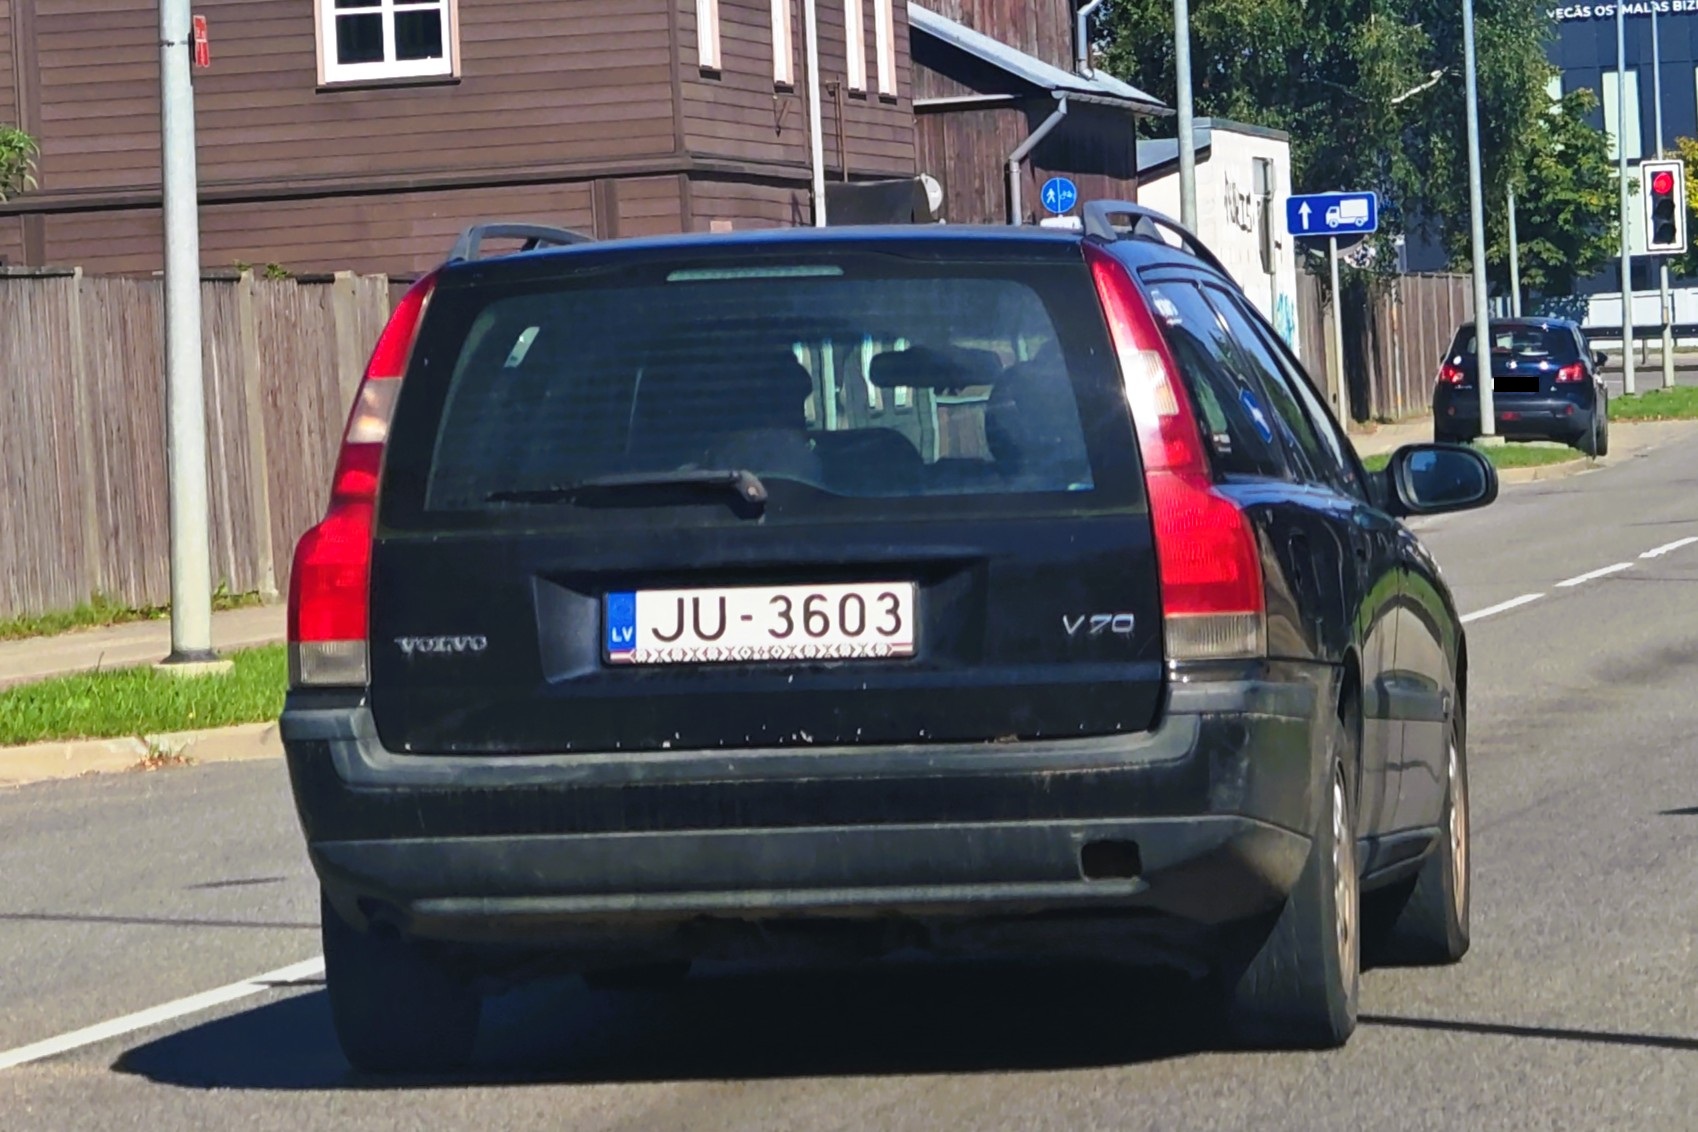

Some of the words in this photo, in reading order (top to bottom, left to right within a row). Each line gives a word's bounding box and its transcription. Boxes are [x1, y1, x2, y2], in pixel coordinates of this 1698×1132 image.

[1594, 0, 1670, 17] OSMALAS
[1672, 0, 1698, 12] BIZ
[651, 591, 903, 643] JU-3603
[1062, 613, 1135, 635] V70
[611, 625, 634, 643] LV
[393, 635, 488, 653] VOLVO
